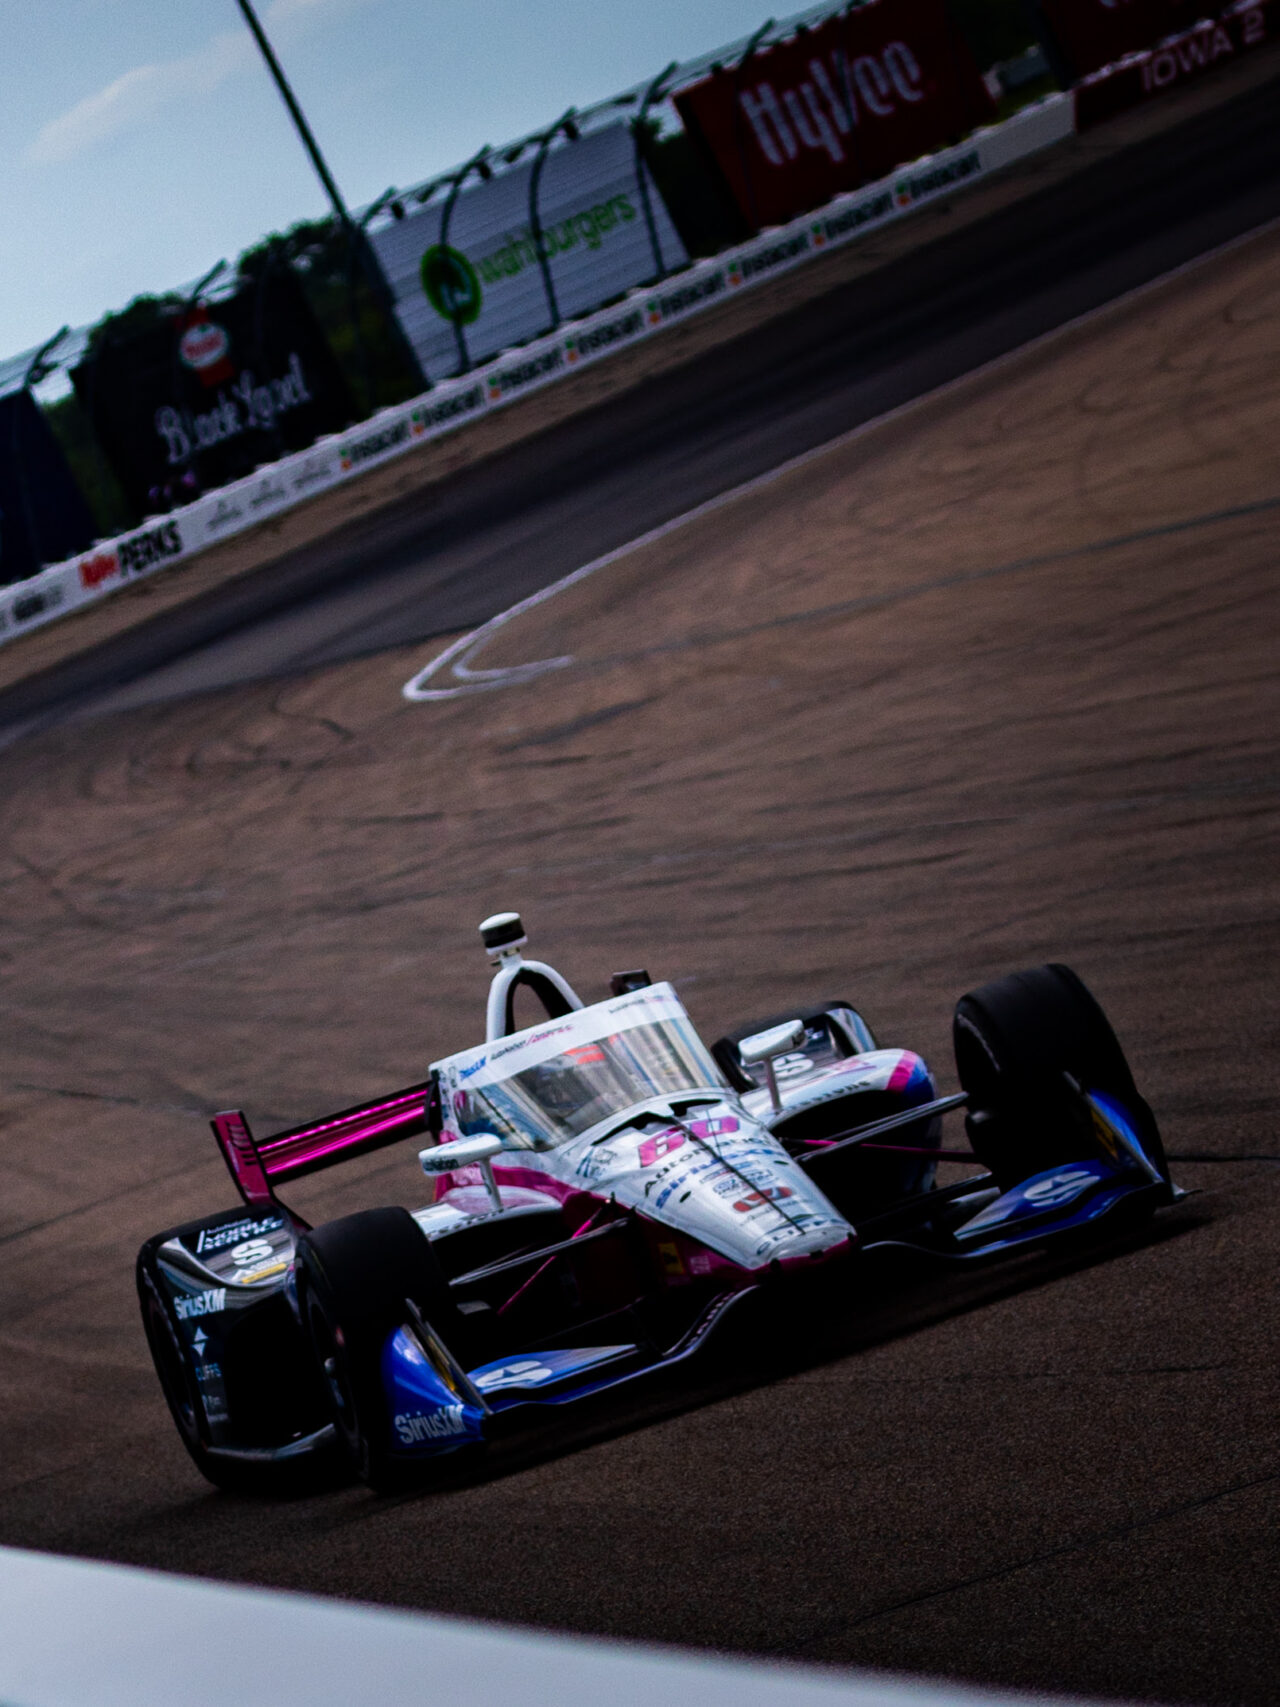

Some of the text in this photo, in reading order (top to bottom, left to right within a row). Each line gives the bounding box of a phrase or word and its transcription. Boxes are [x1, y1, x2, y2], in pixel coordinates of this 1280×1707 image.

[1140, 26, 1233, 94] IOWA
[638, 1115, 740, 1168] 60
[173, 1287, 226, 1320] SiriusXM
[394, 1403, 466, 1445] SiriusXM
